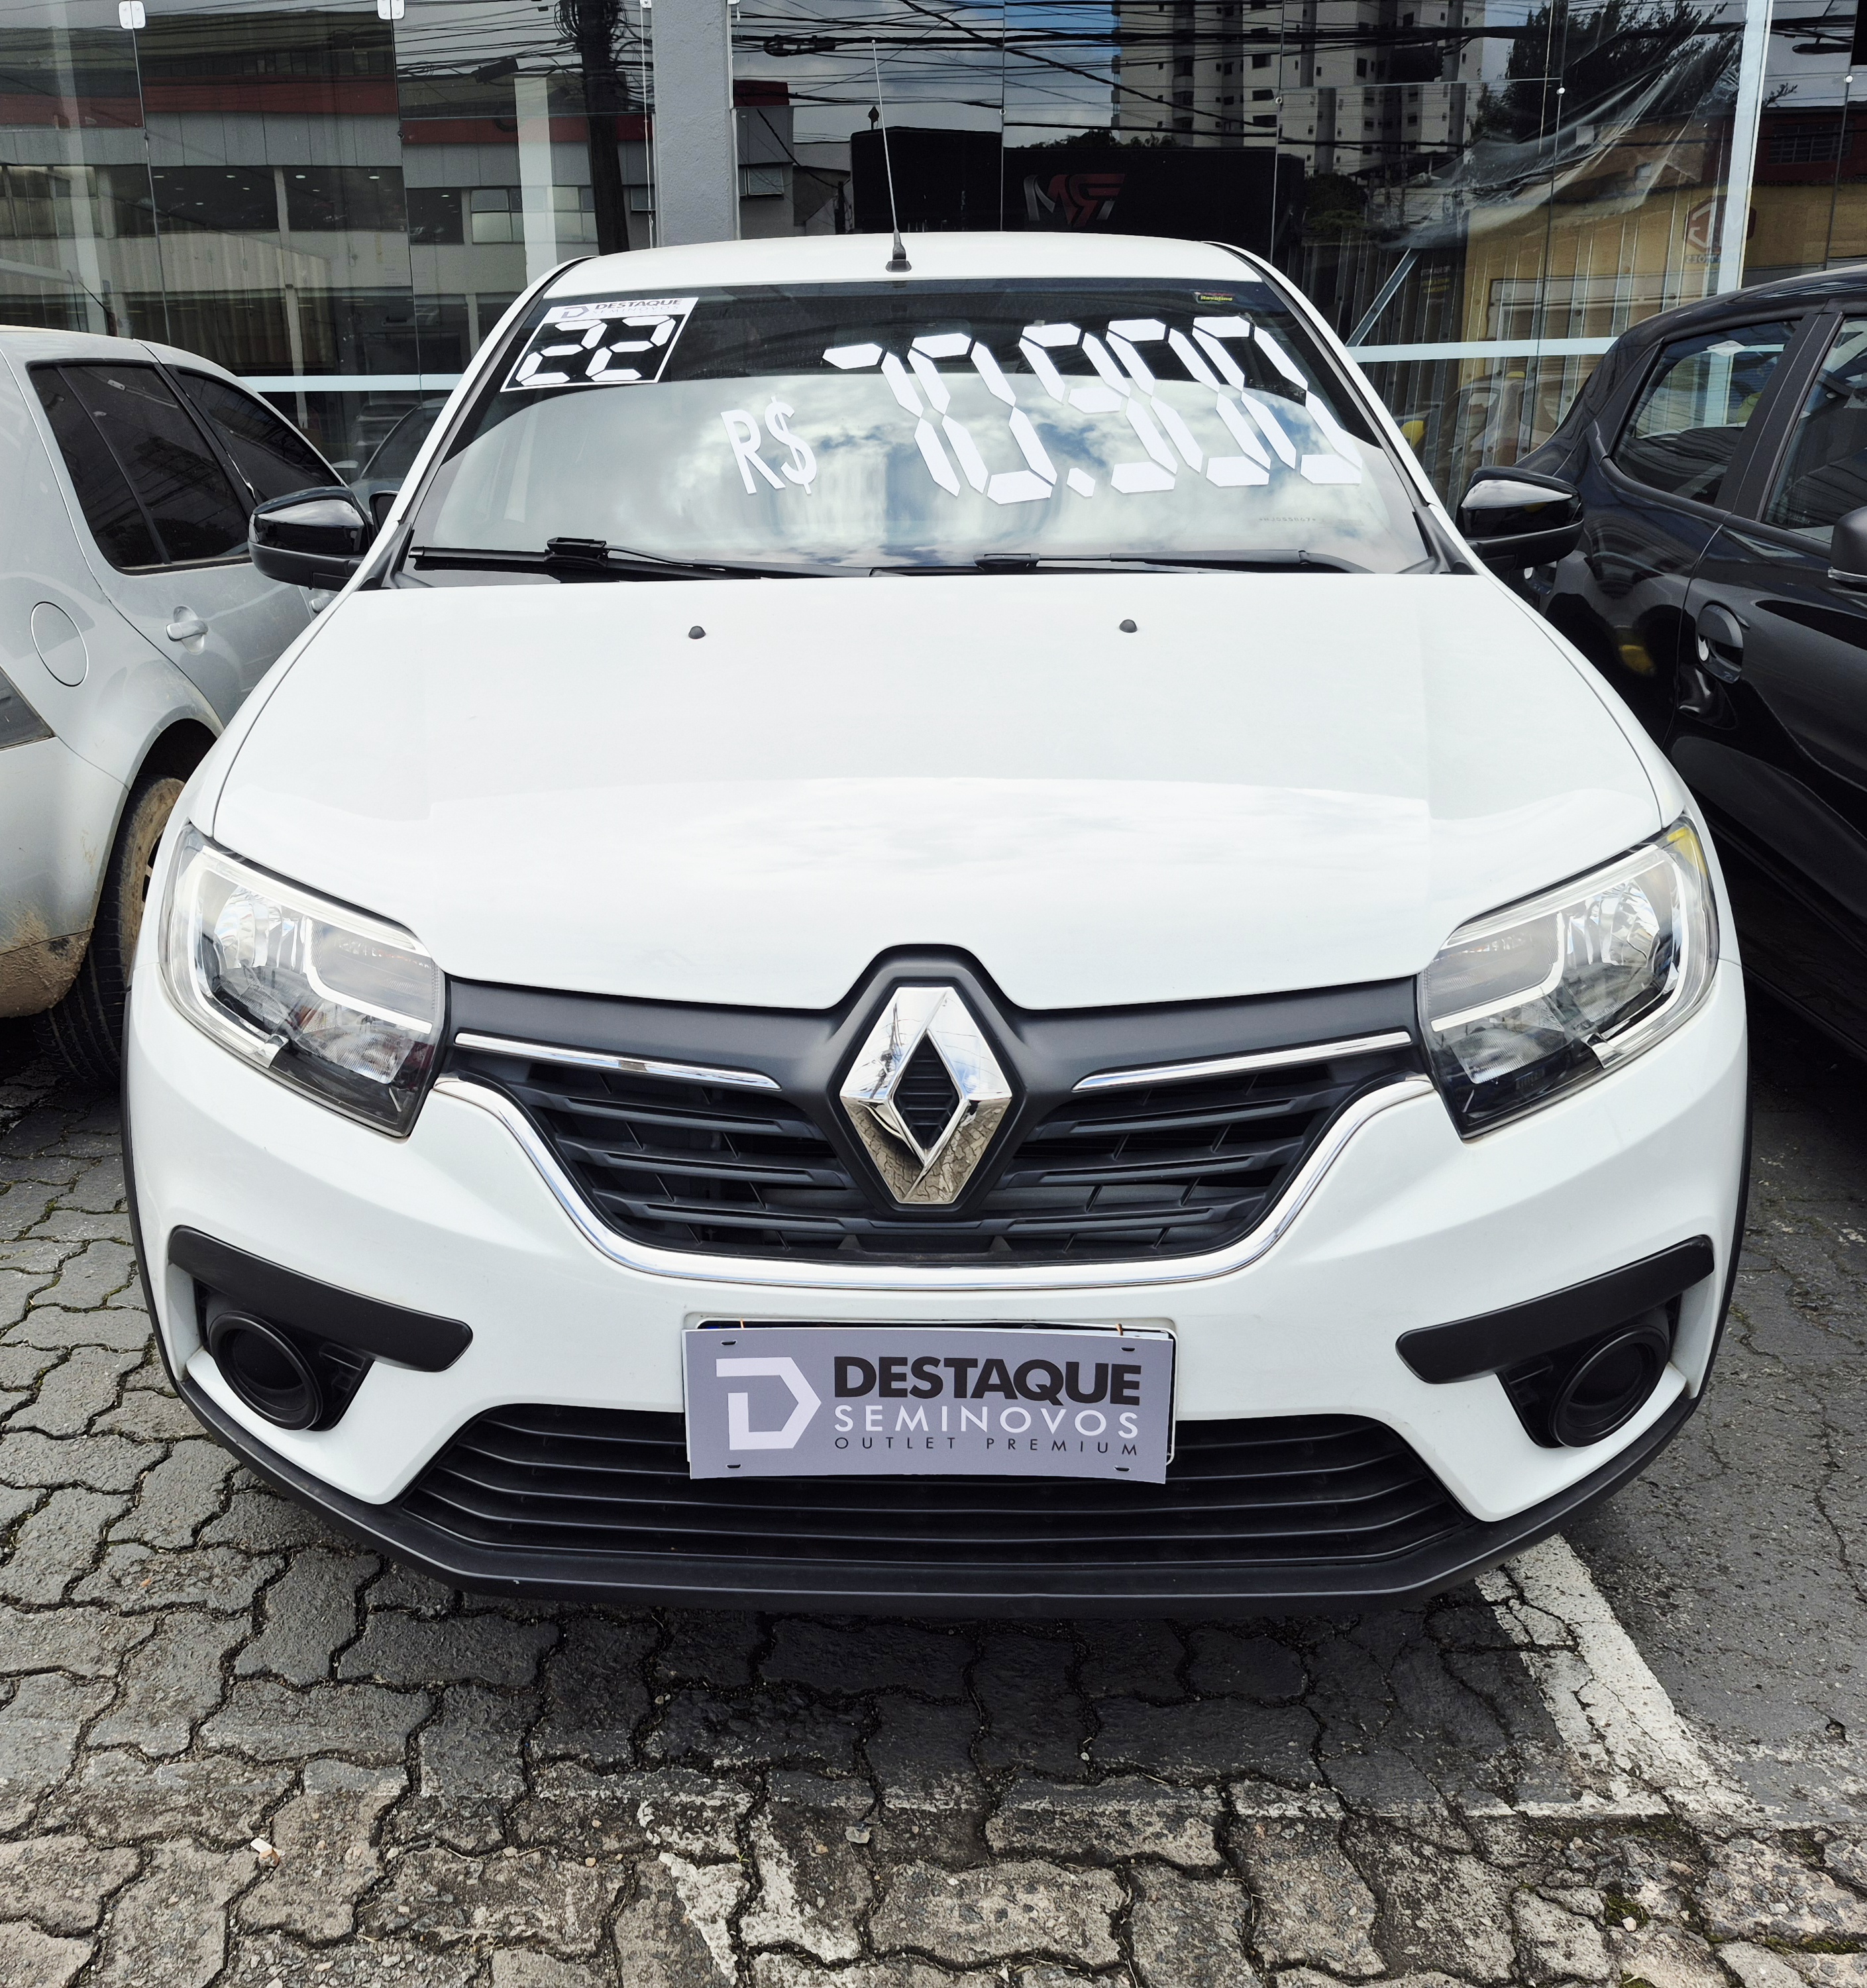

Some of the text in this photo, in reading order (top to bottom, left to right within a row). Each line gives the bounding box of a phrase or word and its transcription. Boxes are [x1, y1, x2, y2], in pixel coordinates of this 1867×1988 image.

[594, 298, 683, 310] DESTAQUE
[515, 315, 676, 386] 22
[720, 315, 1363, 505] R$ 70.900
[833, 1356, 1142, 1406] DESTAQUE
[834, 1404, 1139, 1439] SEMINOVOS
[834, 1437, 1138, 1457] OUTLET PREMIUM
